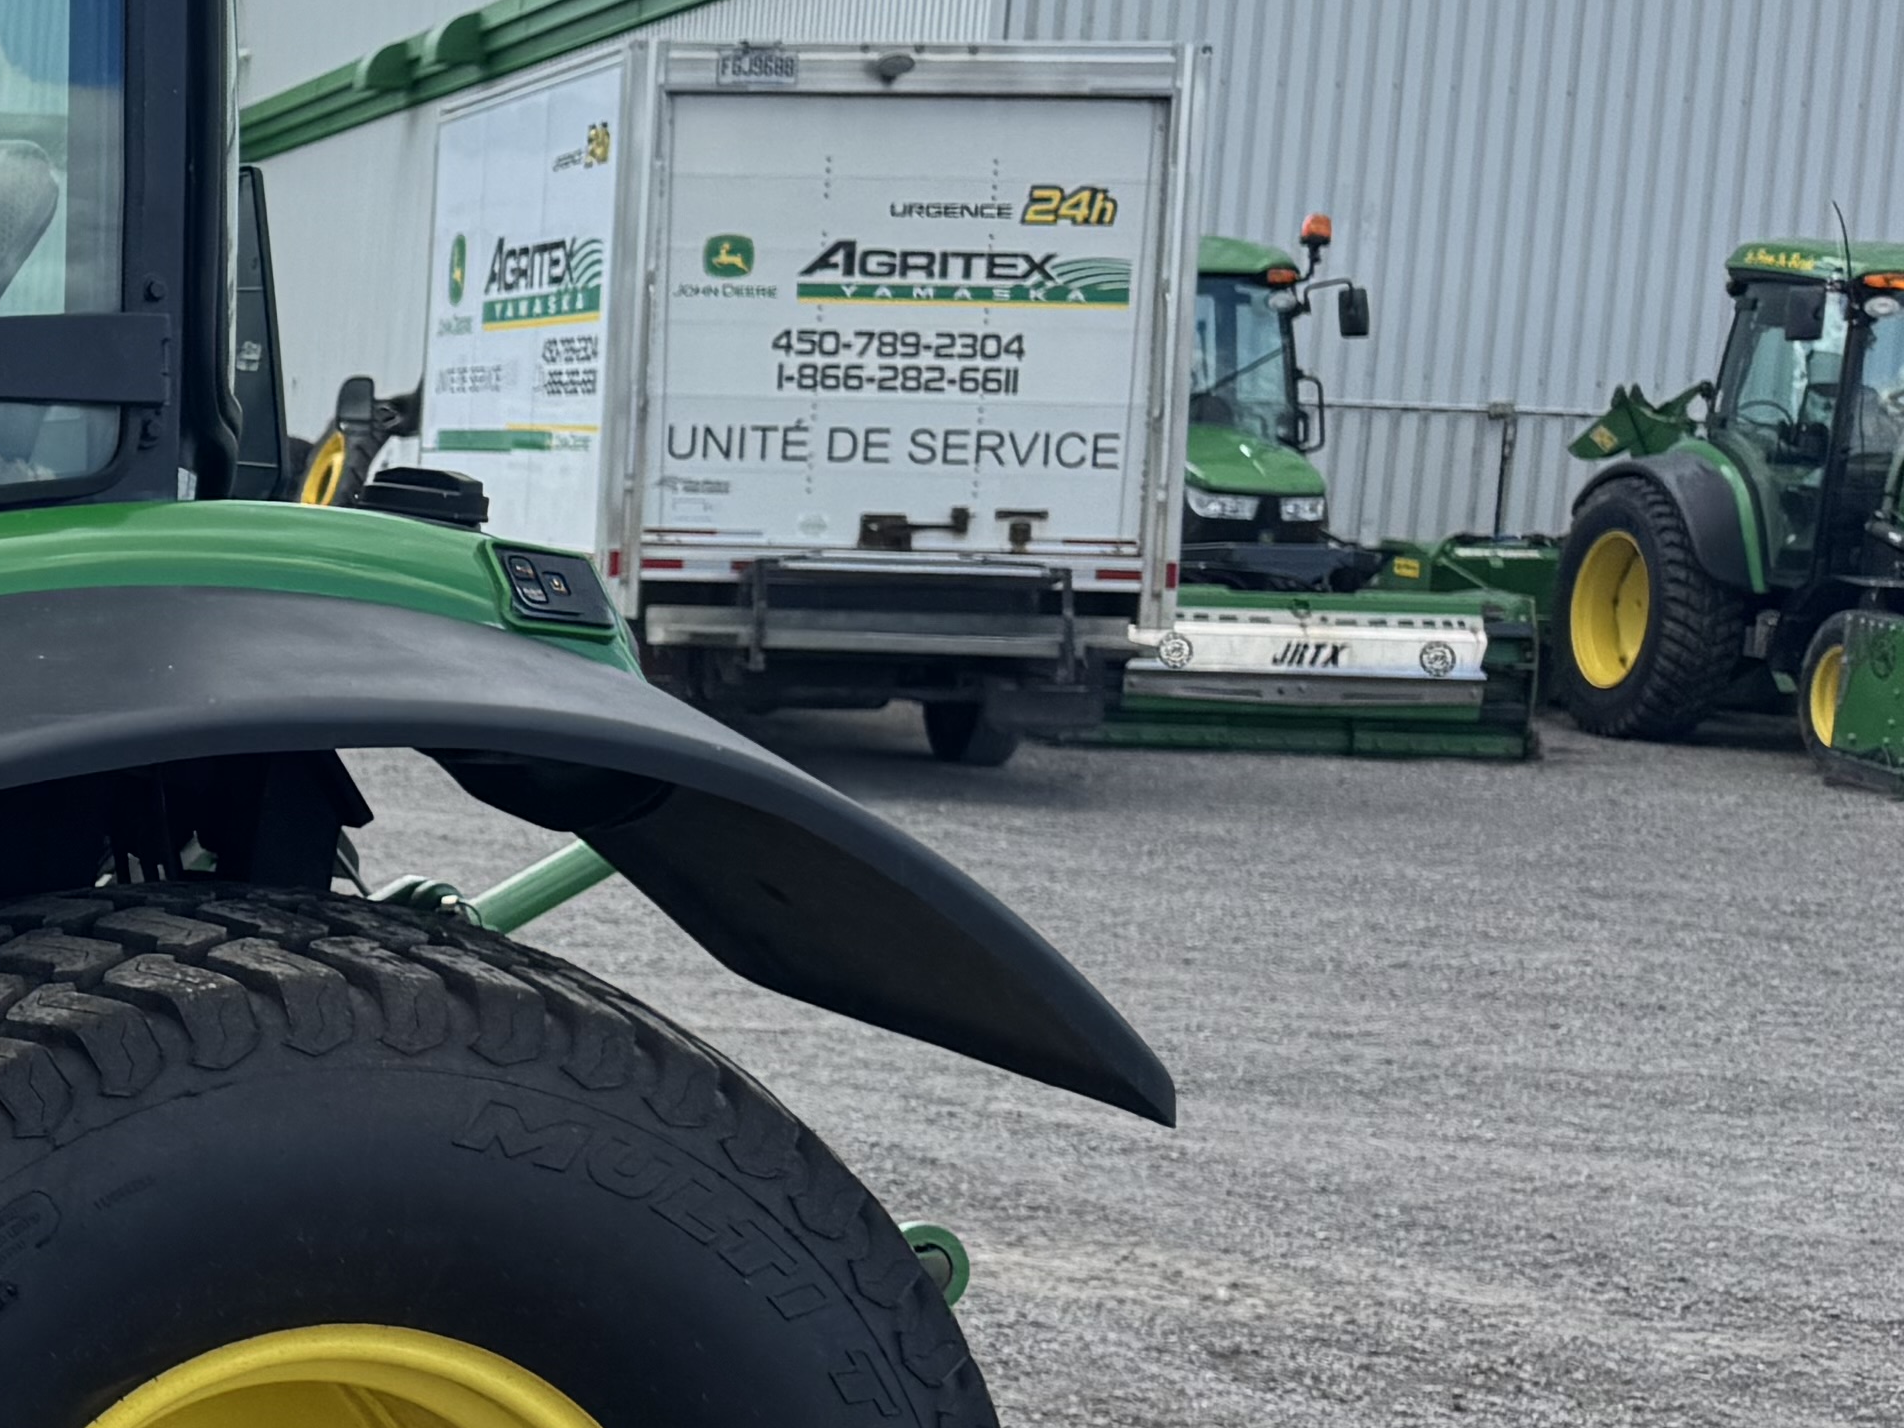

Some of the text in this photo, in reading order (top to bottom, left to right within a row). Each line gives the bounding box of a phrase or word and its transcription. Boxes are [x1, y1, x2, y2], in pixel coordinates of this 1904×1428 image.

[889, 184, 1119, 228] URGENCE 24h
[484, 236, 579, 295] AGRITEX
[798, 239, 1061, 284] AGRITEX
[494, 292, 585, 320] YAMASKA
[672, 282, 779, 300] JOHN DEERE
[840, 285, 1087, 304] YAMASKA
[771, 329, 1027, 362] 450-789-2304
[776, 363, 1021, 396] 1-866-282-6611
[666, 417, 1121, 471] UNITÉ DE SERVICE
[451, 1099, 829, 1322] MULTI
